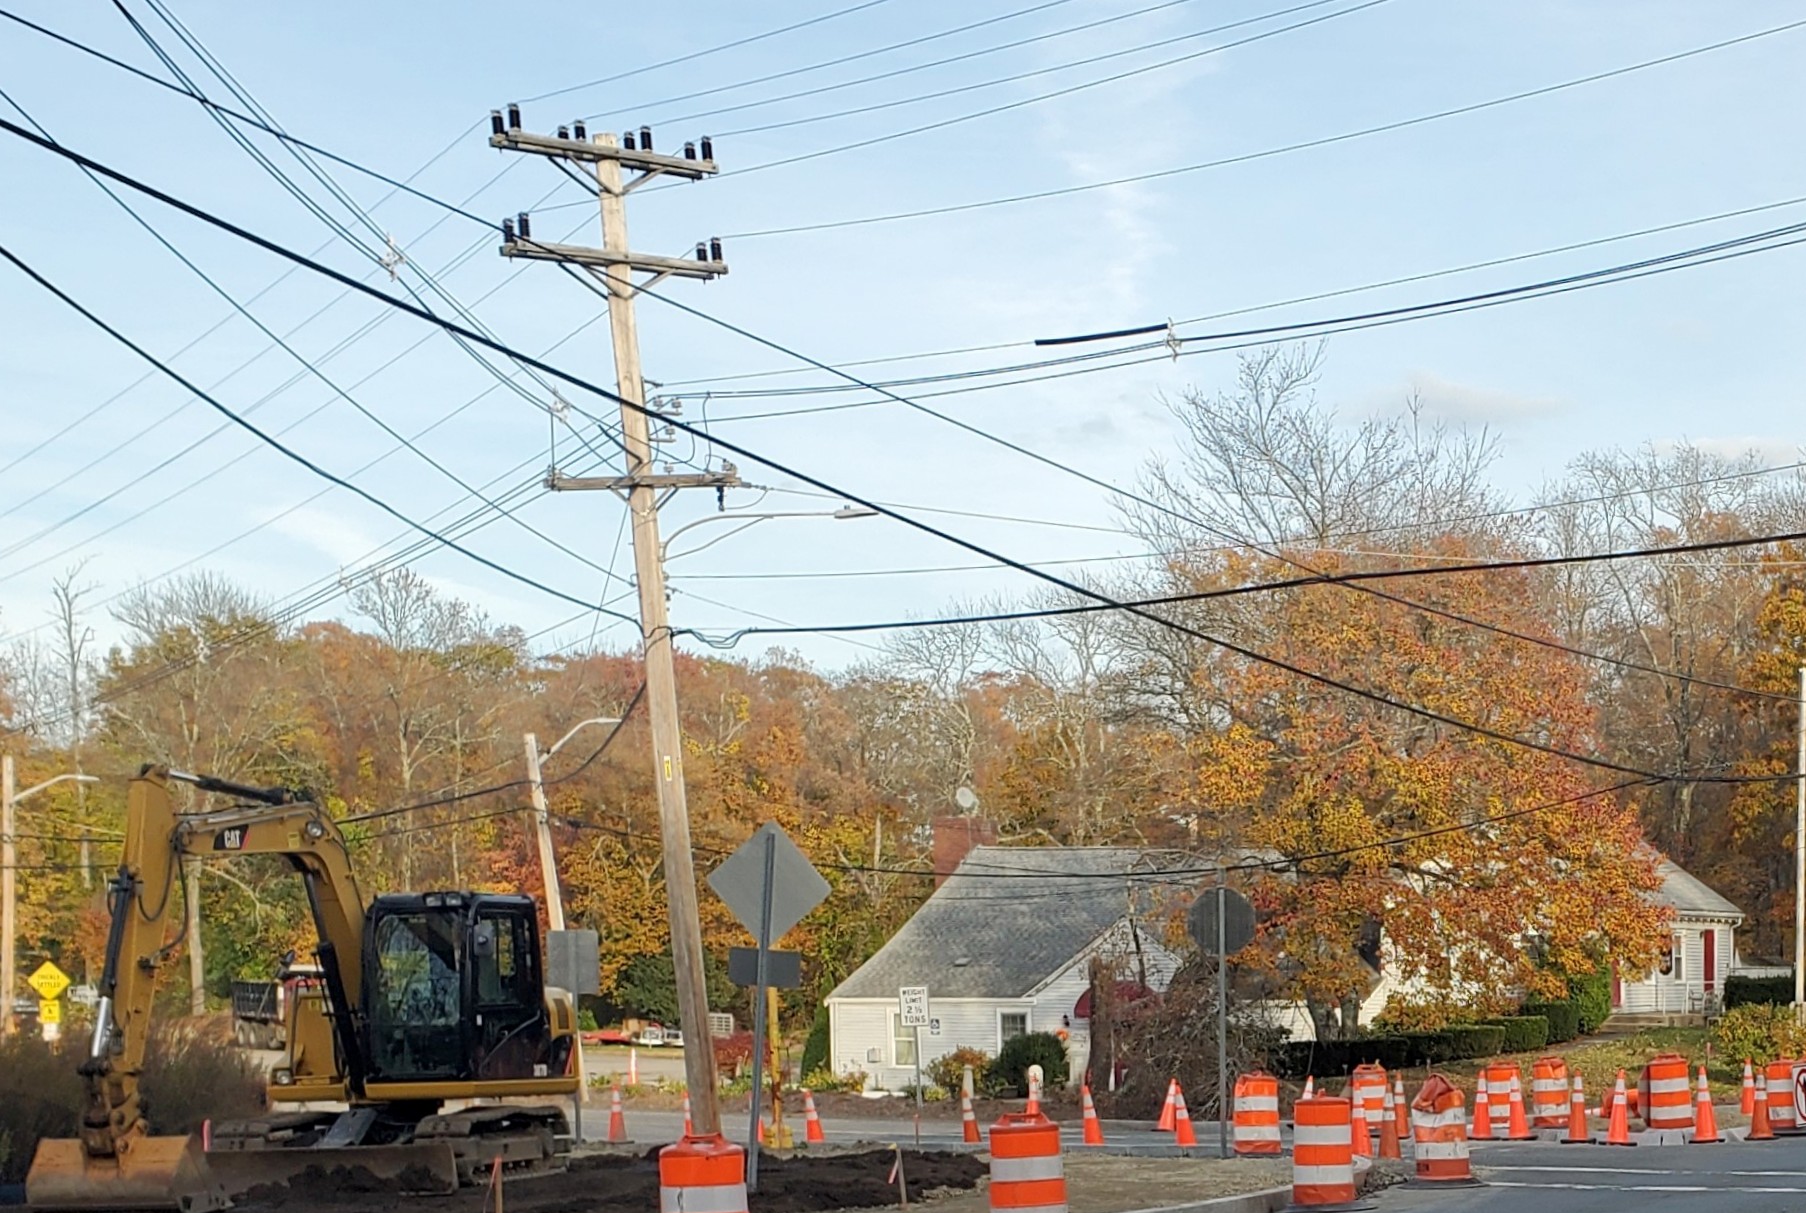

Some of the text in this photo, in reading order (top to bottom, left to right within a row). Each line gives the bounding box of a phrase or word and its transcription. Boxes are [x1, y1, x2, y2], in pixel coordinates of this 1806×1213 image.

[224, 830, 240, 848] CAT
[902, 988, 925, 996] WEIGHT
[904, 996, 922, 1004] LIMIT
[904, 1014, 926, 1024] TONS
